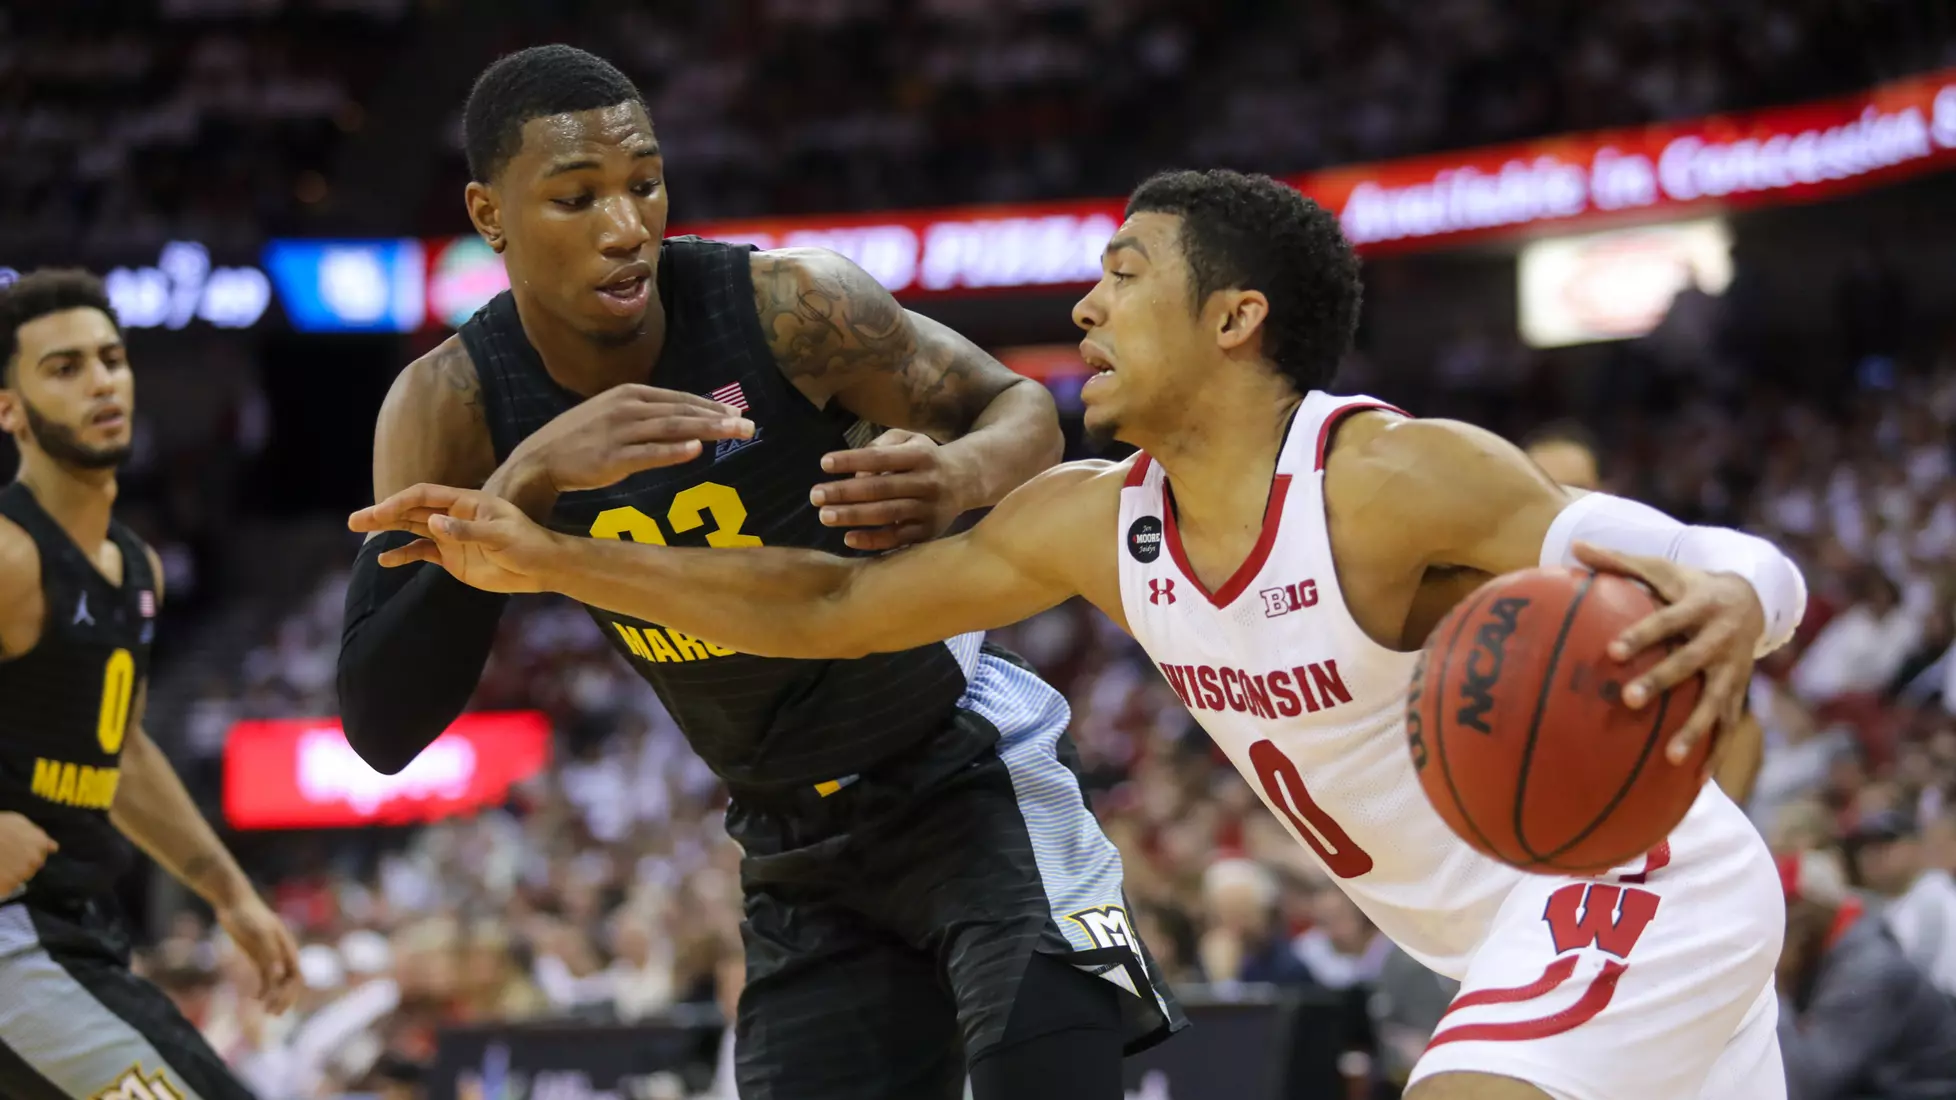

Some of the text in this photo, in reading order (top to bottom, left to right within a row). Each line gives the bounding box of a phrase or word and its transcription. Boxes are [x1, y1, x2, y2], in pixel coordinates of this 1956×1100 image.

[97, 647, 135, 755] 0
[1159, 659, 1353, 719] WISCONSIN
[1457, 597, 1530, 735] NCAA
[1248, 739, 1373, 878] 0
